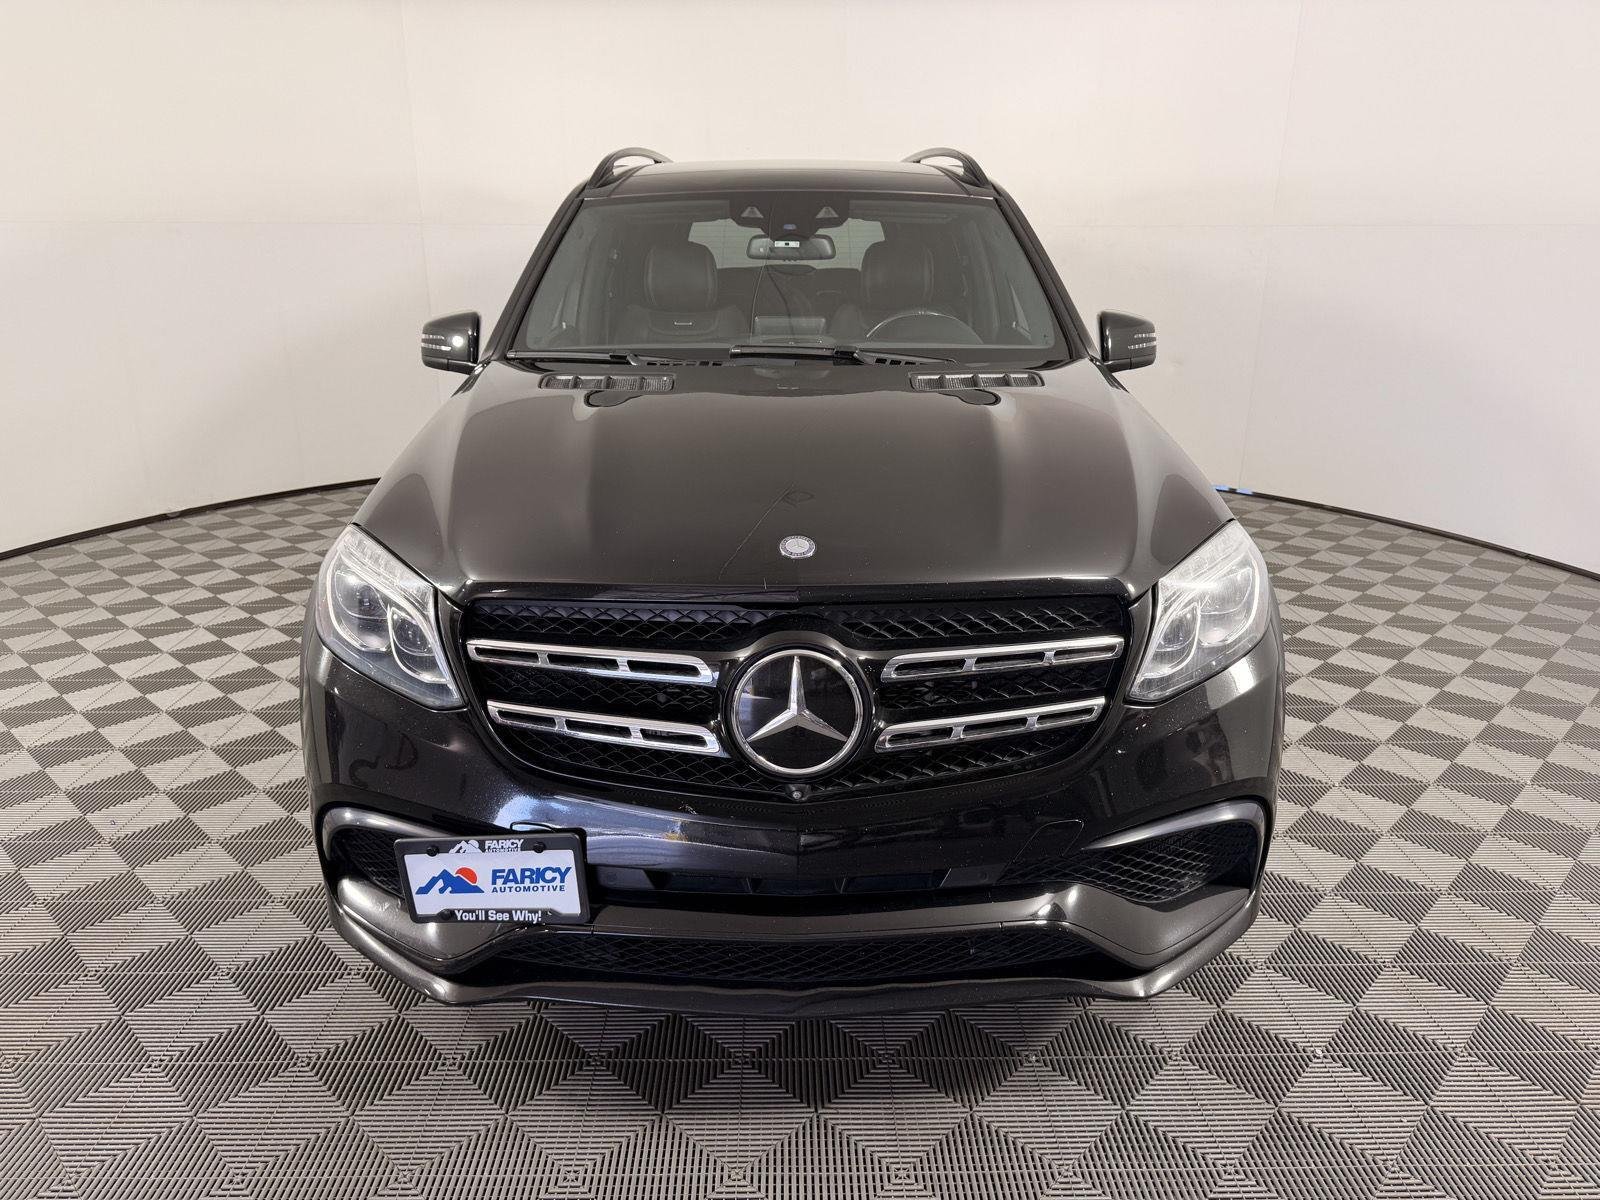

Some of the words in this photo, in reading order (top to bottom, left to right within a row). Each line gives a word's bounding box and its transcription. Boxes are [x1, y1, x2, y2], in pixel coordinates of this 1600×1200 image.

[485, 839, 524, 849] FARICY
[491, 866, 572, 885] FARICY
[491, 885, 566, 893] AUTOMOTIVE
[454, 910, 486, 921] You'll
[488, 909, 509, 921] See
[512, 909, 542, 923] Why!
